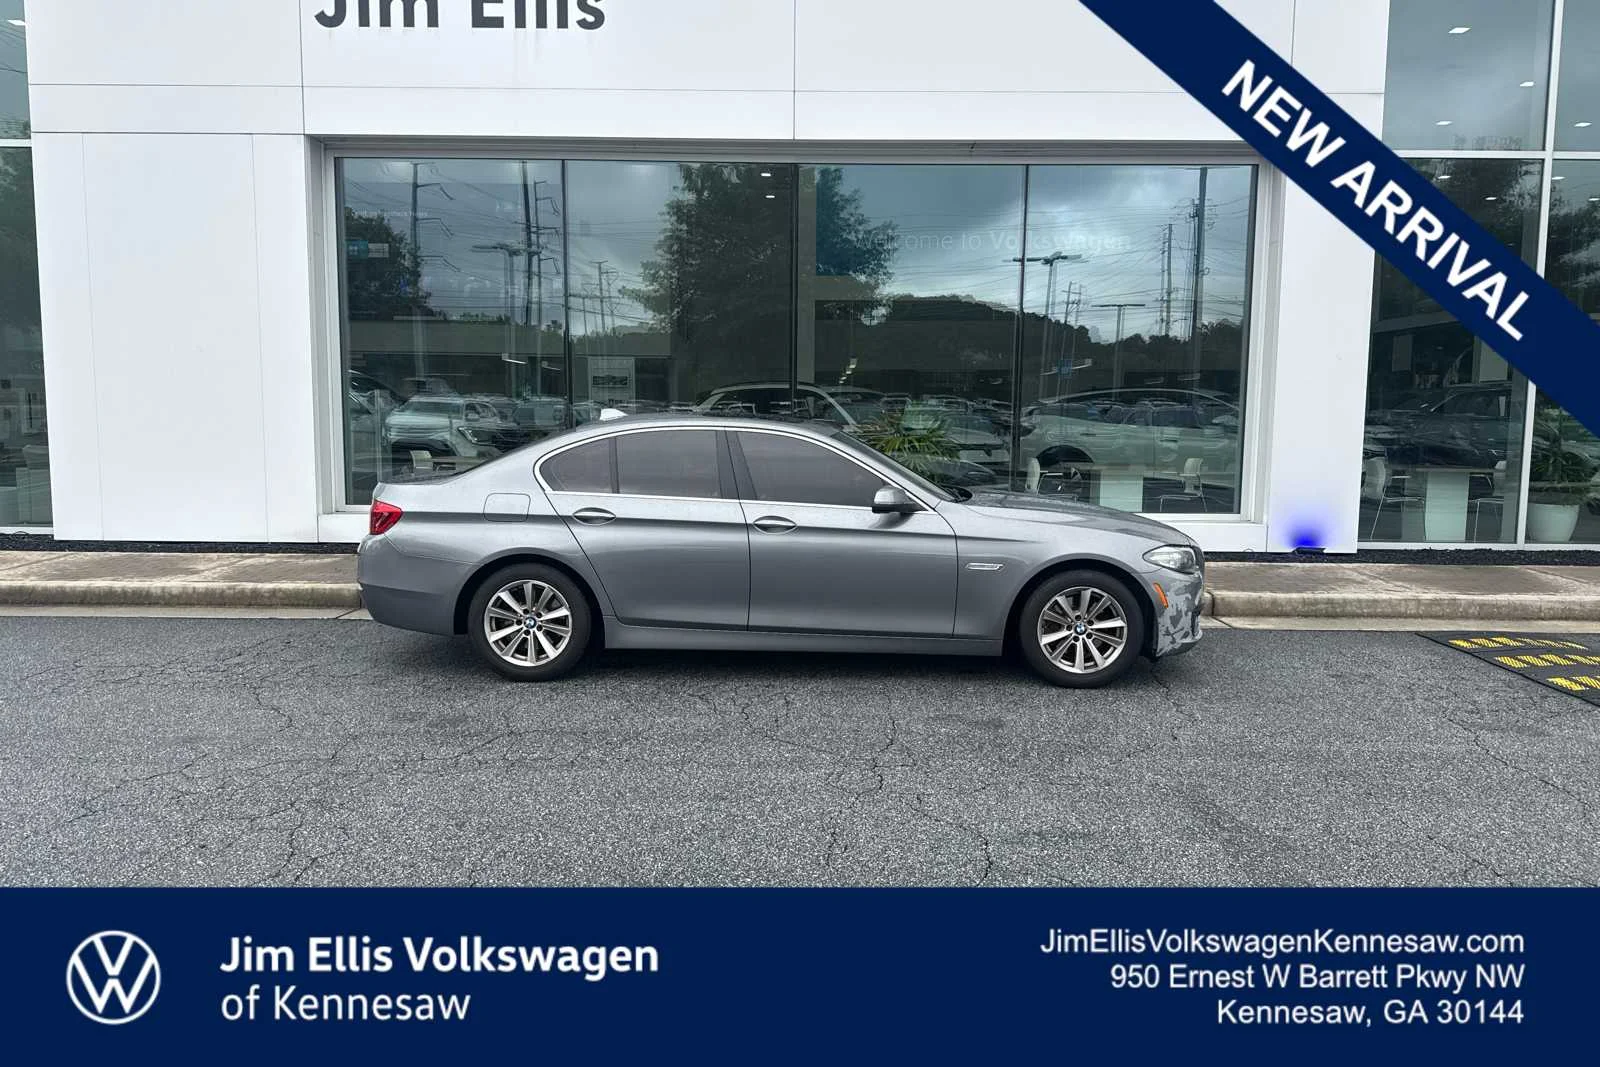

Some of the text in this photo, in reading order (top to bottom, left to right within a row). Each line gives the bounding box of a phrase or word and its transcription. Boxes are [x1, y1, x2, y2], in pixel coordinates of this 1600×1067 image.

[314, 0, 605, 30] Jim Ellis
[990, 229, 1131, 255] Vokswagen
